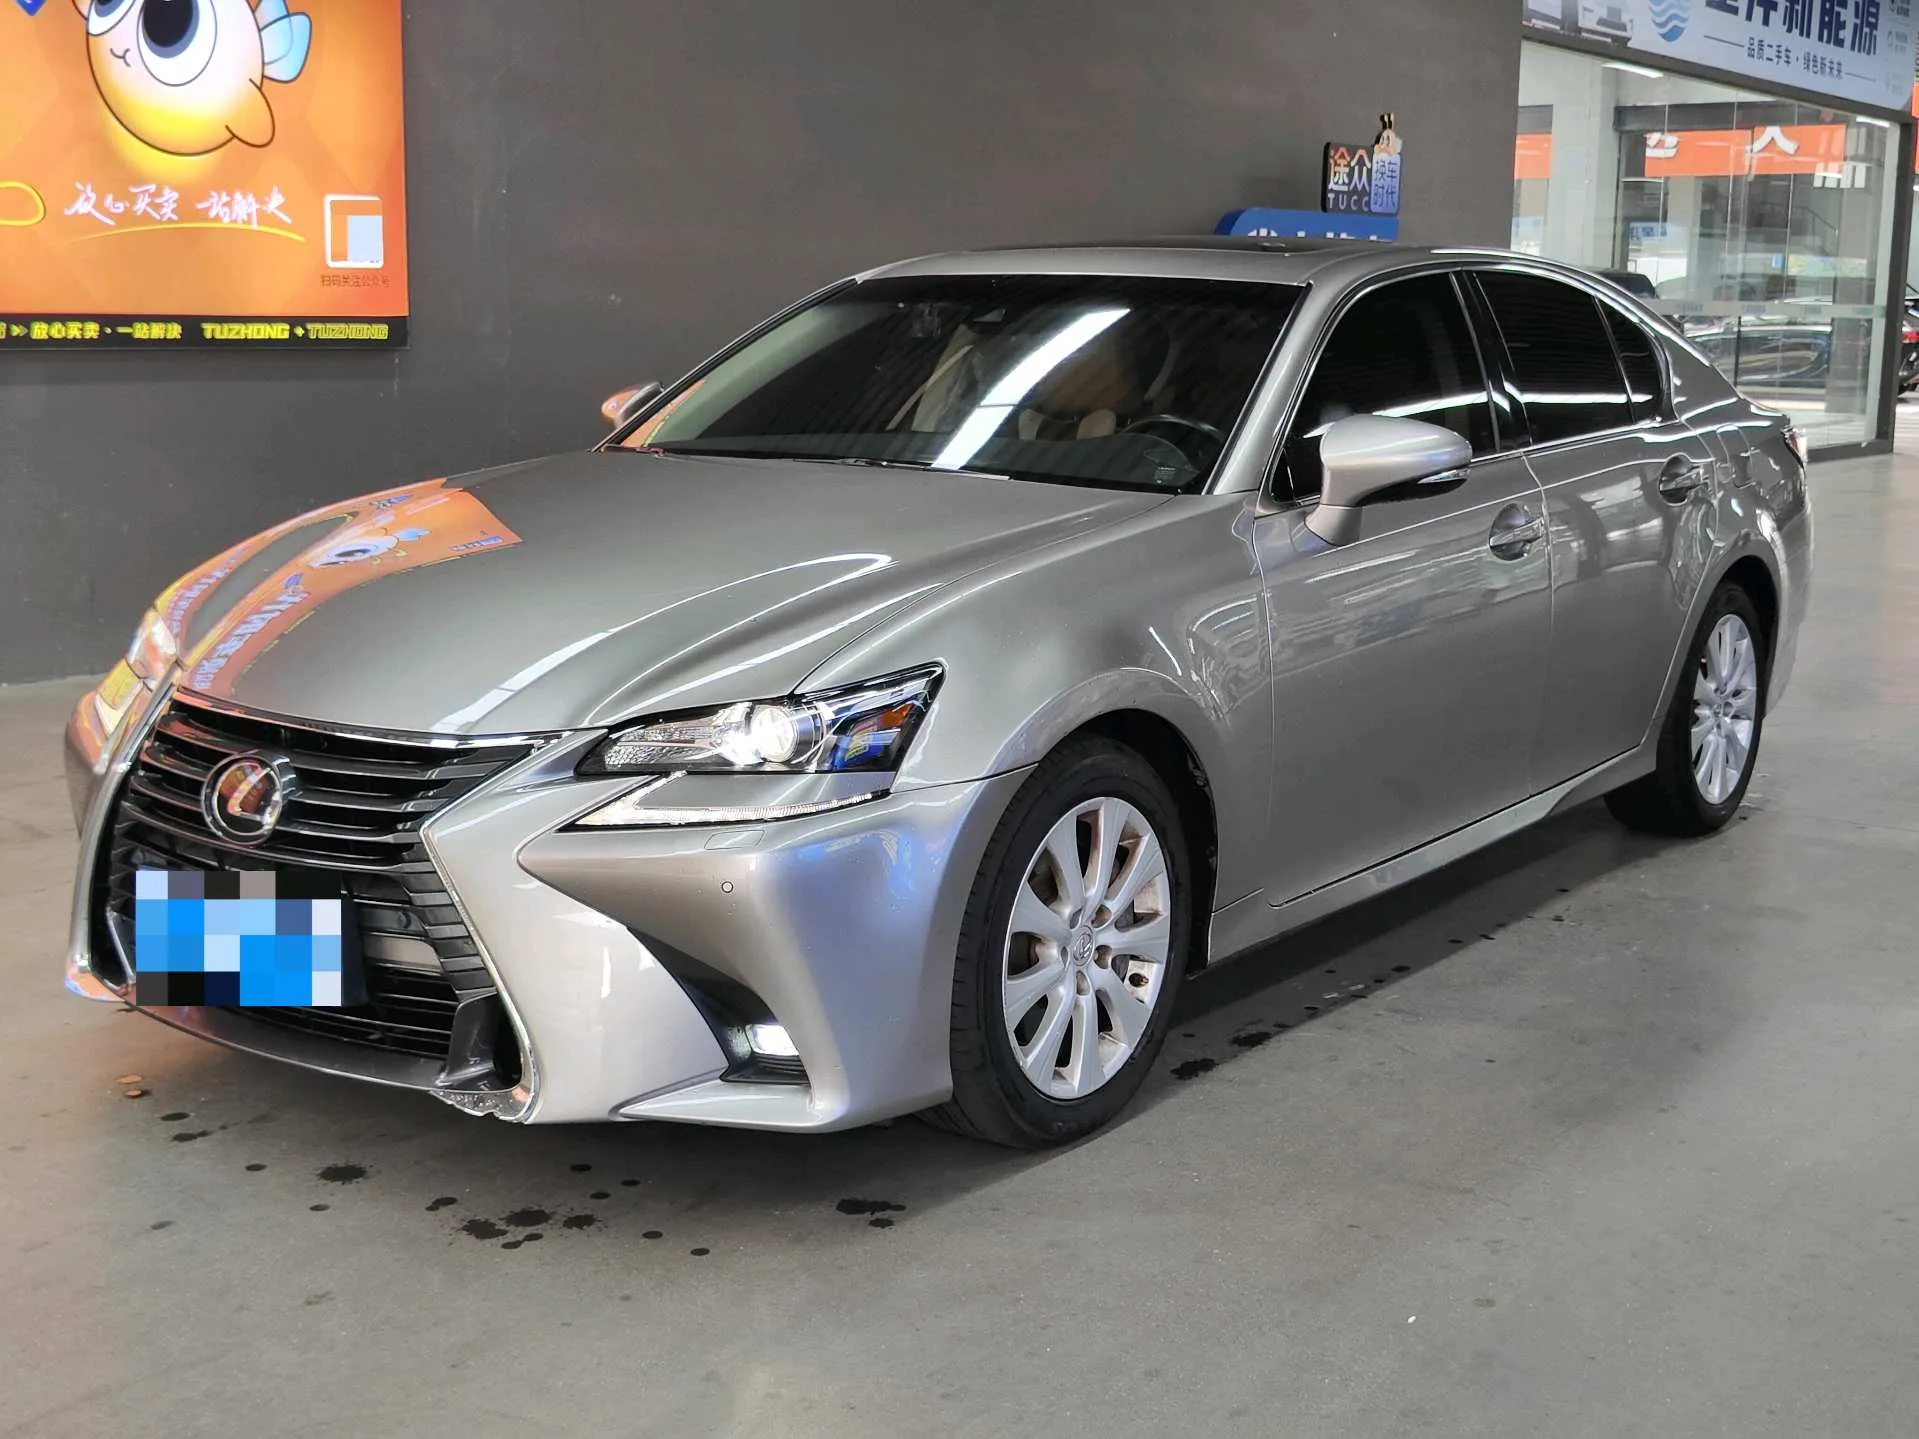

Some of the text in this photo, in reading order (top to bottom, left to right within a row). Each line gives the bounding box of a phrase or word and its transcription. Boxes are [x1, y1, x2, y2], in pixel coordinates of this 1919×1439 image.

[1705, 0, 1880, 56] 新能源
[1328, 146, 1372, 192] 途众
[64, 181, 180, 226] 放心买卖
[320, 274, 392, 288] 扫码关注公众号
[201, 322, 290, 340] TUZHONG
[306, 322, 389, 340] TUZHONG
